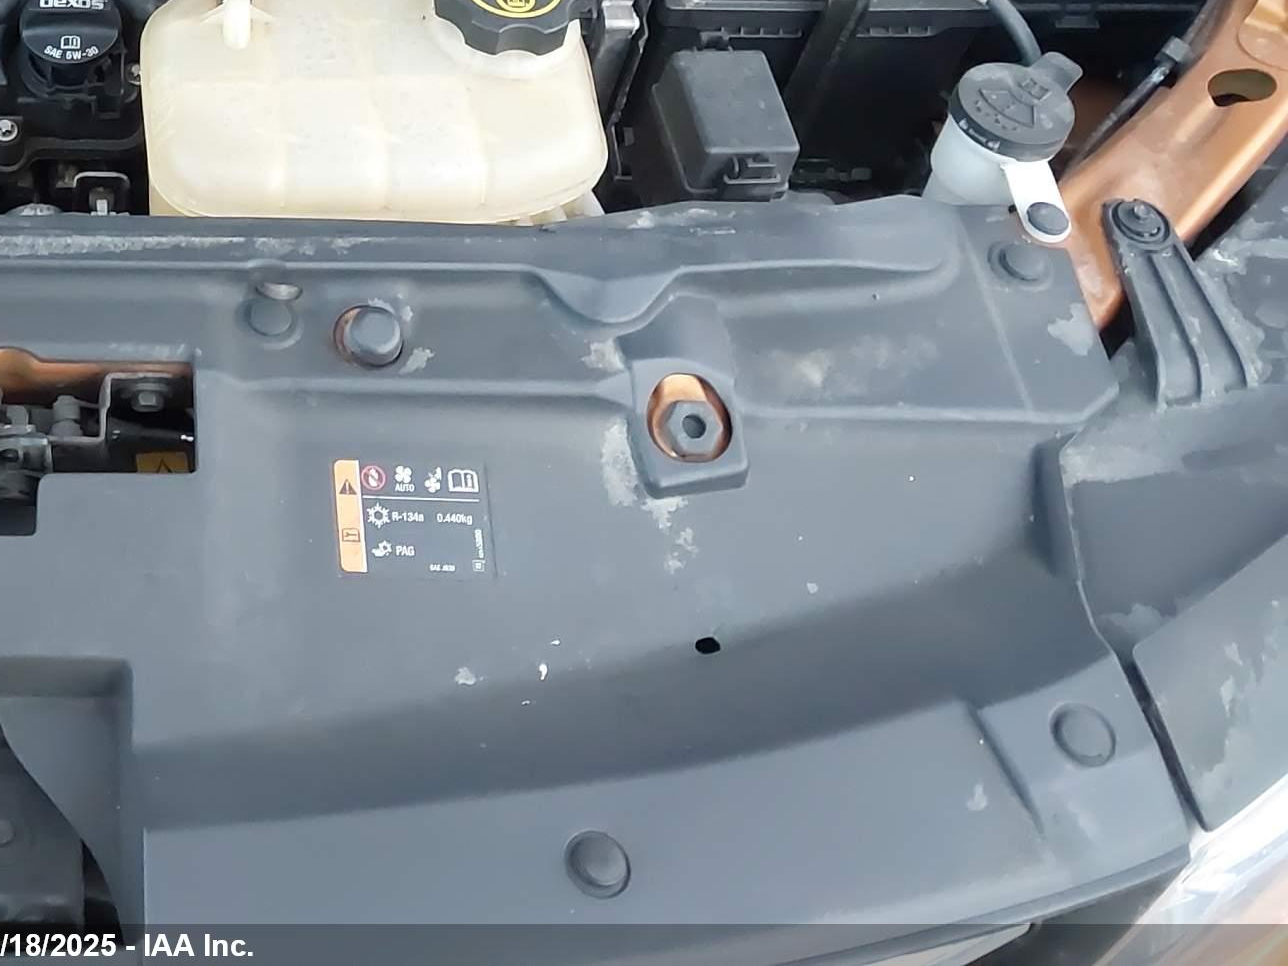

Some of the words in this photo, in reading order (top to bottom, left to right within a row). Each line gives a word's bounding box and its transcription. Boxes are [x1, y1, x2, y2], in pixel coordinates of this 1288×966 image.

[44, 46, 63, 59] SAE
[65, 46, 99, 60] 5W-30
[395, 484, 415, 492] AUTO
[391, 512, 425, 523] R-134a
[436, 513, 473, 526] 0.440kg
[395, 545, 416, 557] PAG
